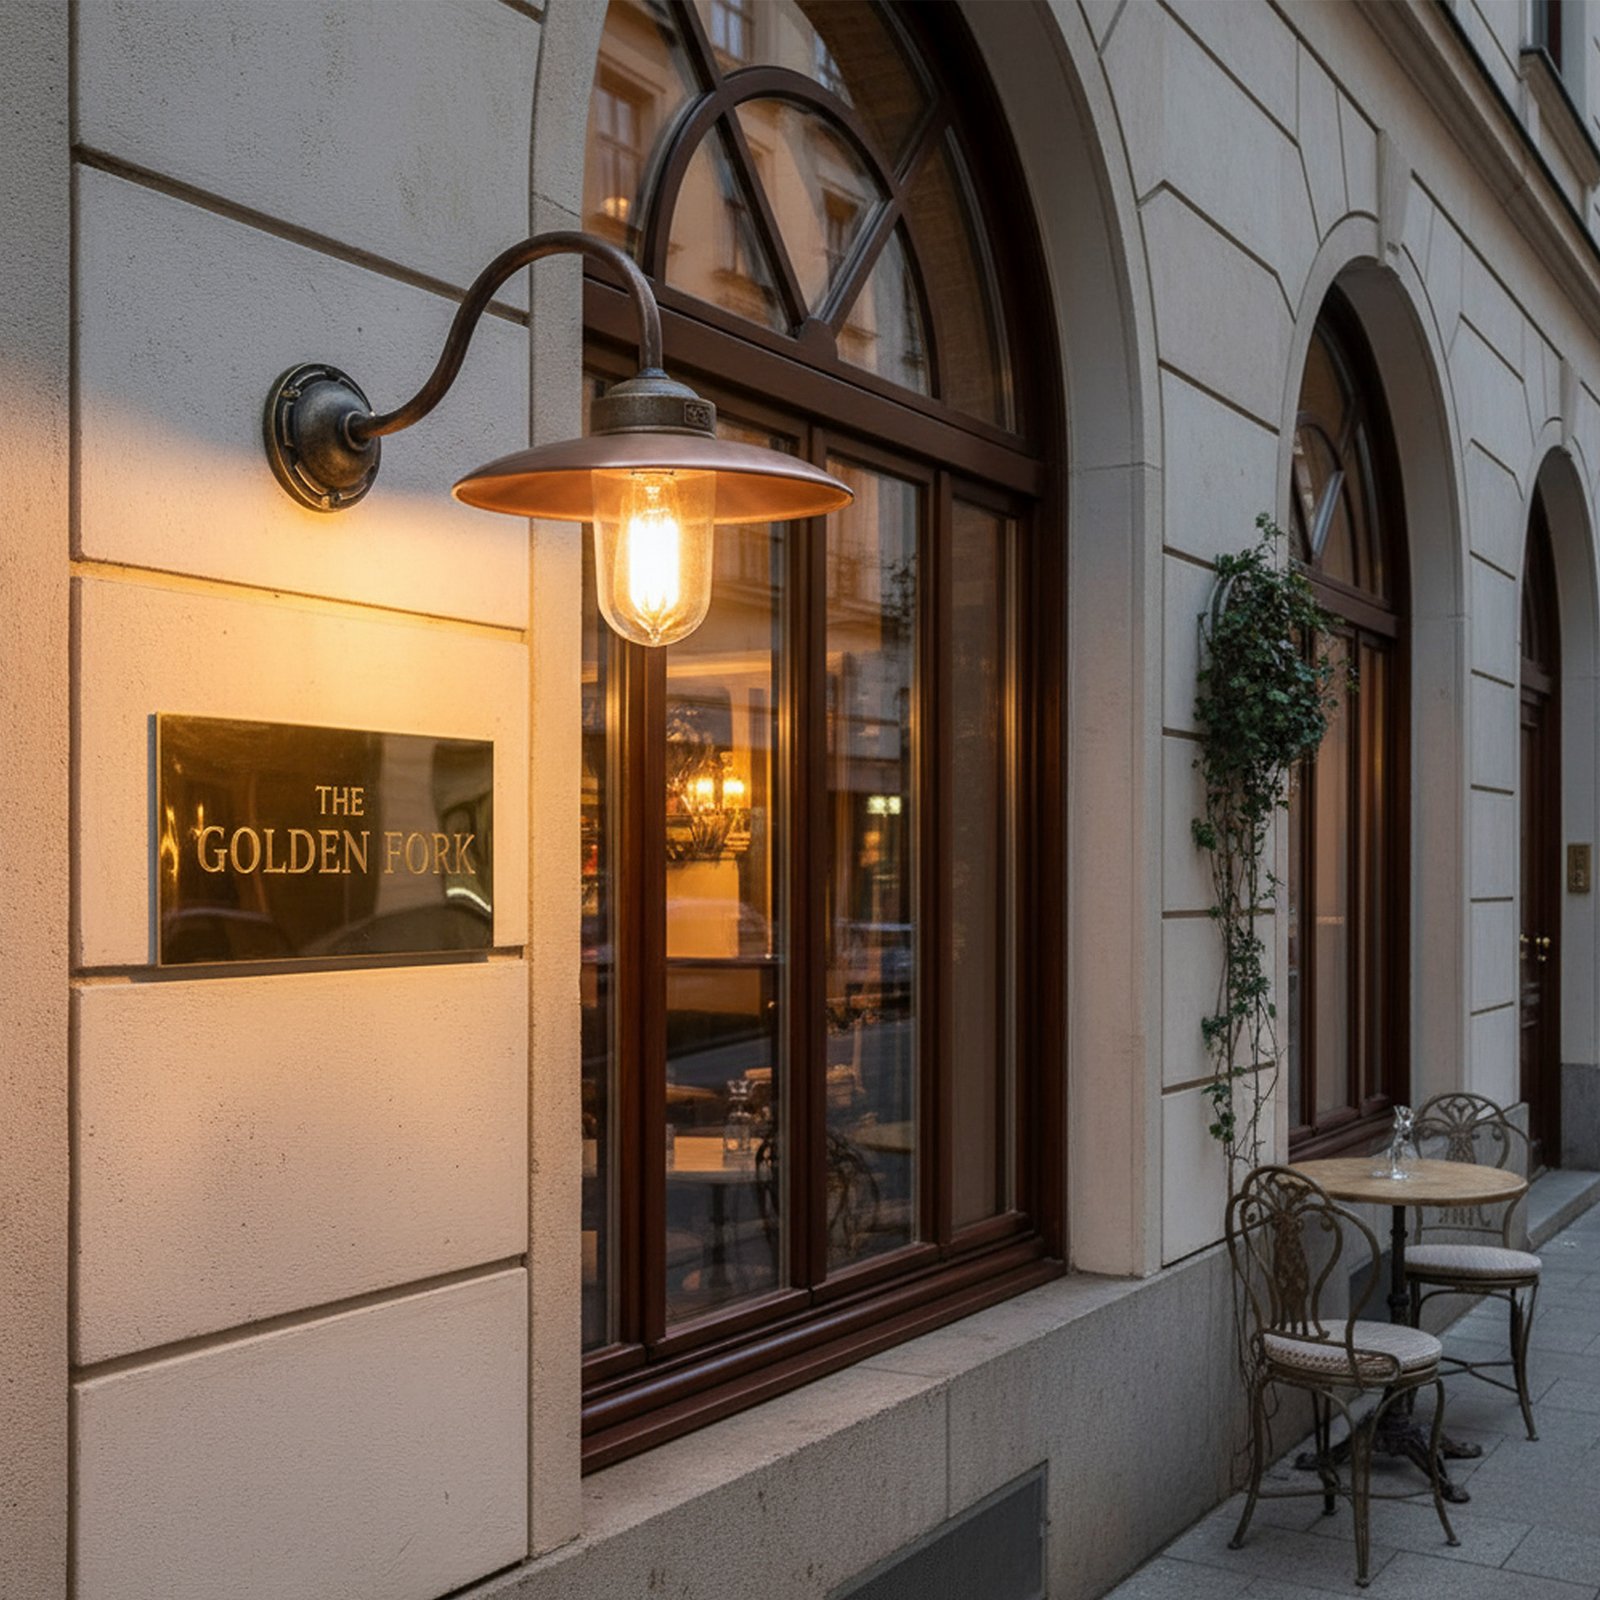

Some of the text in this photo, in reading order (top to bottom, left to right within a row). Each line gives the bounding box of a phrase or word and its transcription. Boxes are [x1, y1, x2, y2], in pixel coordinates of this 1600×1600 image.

[315, 785, 365, 816] THE
[197, 826, 476, 875] GOLDEN FORK
